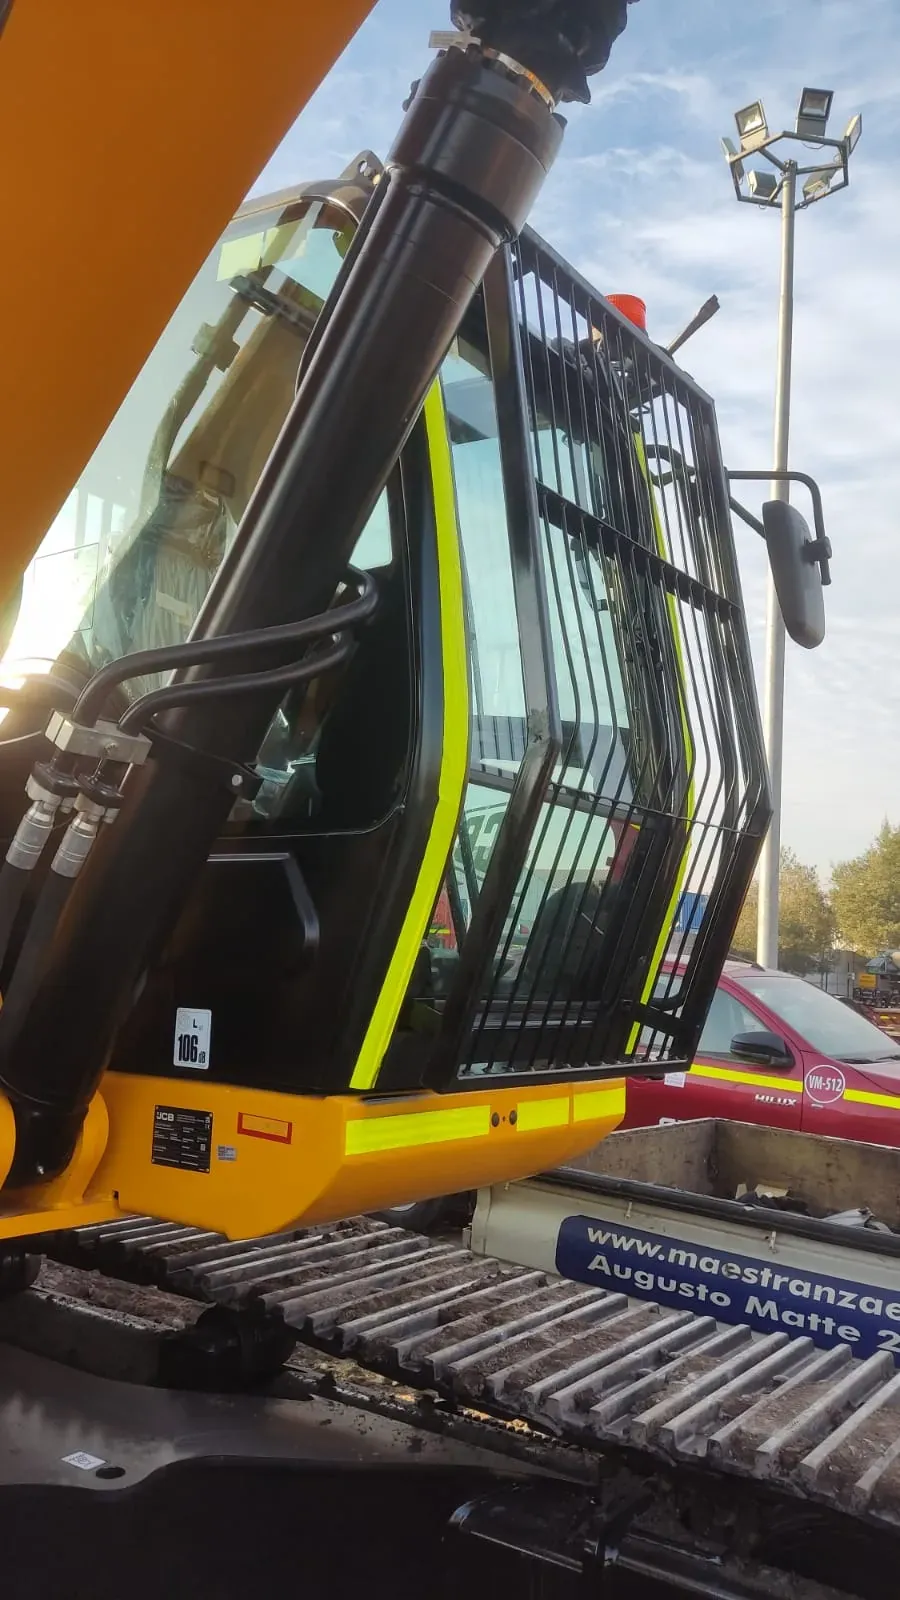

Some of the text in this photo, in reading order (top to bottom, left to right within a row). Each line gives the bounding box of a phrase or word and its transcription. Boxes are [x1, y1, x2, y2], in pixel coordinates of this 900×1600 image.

[178, 1033, 199, 1063] 106
[808, 1074, 843, 1093] VM-512
[755, 1093, 798, 1107] HILUX
[156, 1111, 175, 1122] JCB
[587, 1254, 732, 1308] Augusto
[744, 1295, 861, 1342] Matte
